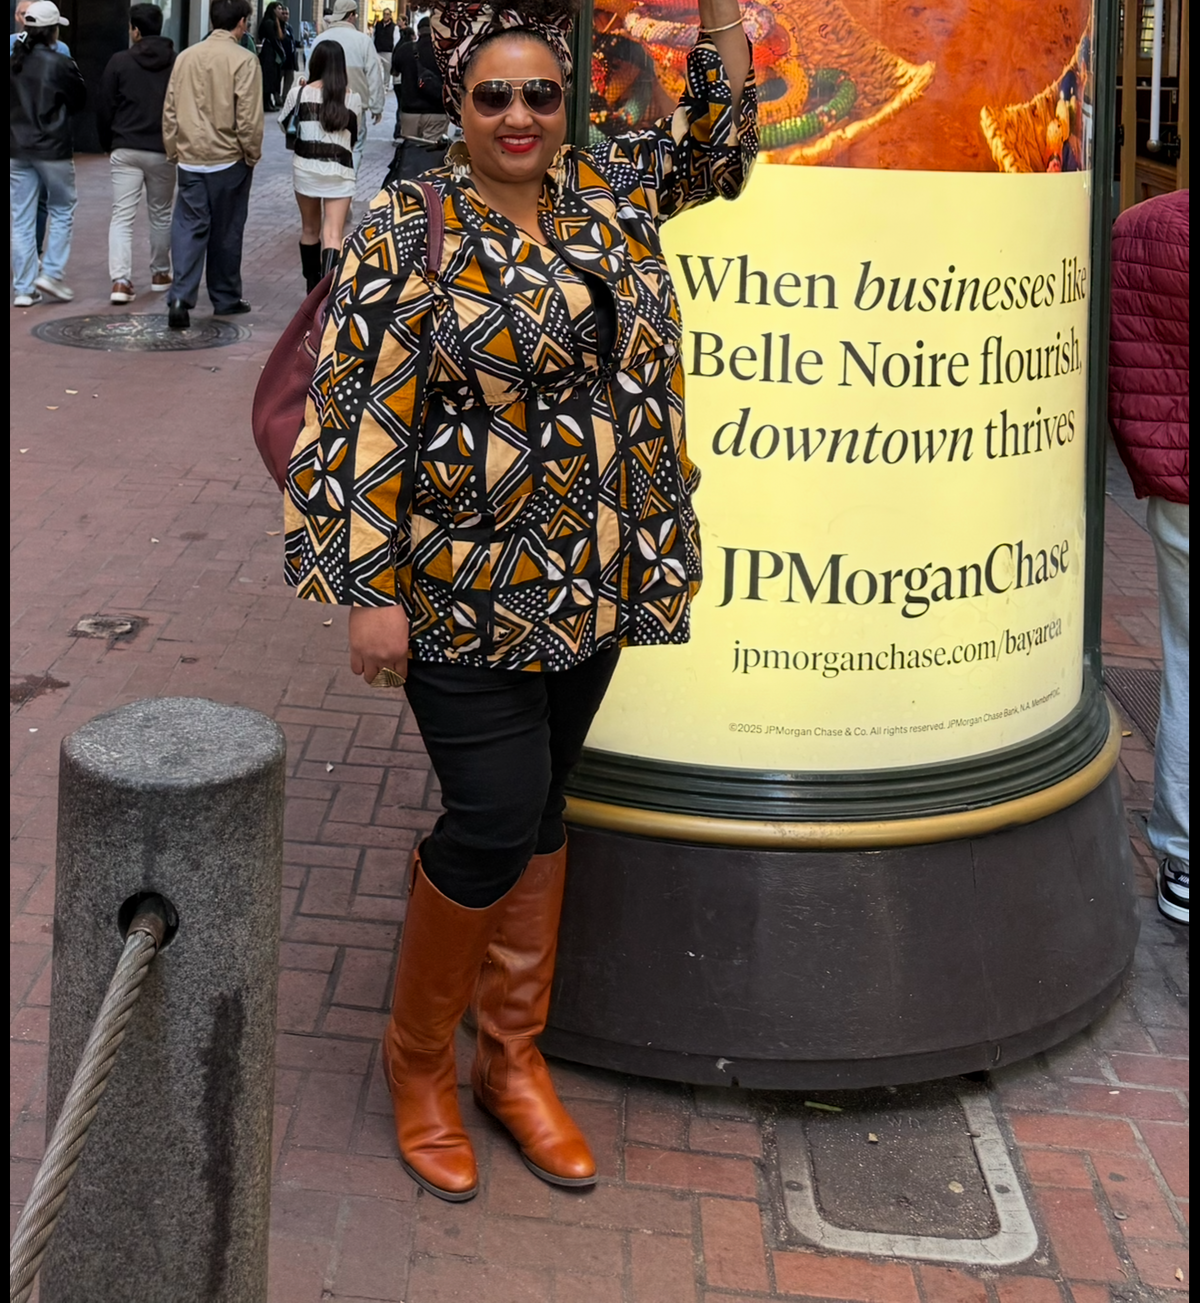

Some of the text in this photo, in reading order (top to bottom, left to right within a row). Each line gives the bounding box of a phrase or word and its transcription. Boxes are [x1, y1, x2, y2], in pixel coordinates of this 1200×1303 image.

[677, 253, 1087, 312] When businesses like
[687, 325, 1083, 388] Belle Noire flourish,
[711, 406, 1076, 465] downtown thrives
[715, 538, 1070, 619] JPMorganChase
[732, 617, 1063, 679] jpmorganchase.com/bayarea
[764, 725, 812, 737] JPMorgan
[814, 727, 843, 737] Chase
[844, 727, 852, 736] &
[854, 727, 868, 736] Co.
[870, 726, 882, 736] All
[883, 725, 908, 737] rights
[909, 722, 945, 734] reserved.
[947, 715, 983, 729] JPMorgan
[983, 711, 1003, 722] Chase
